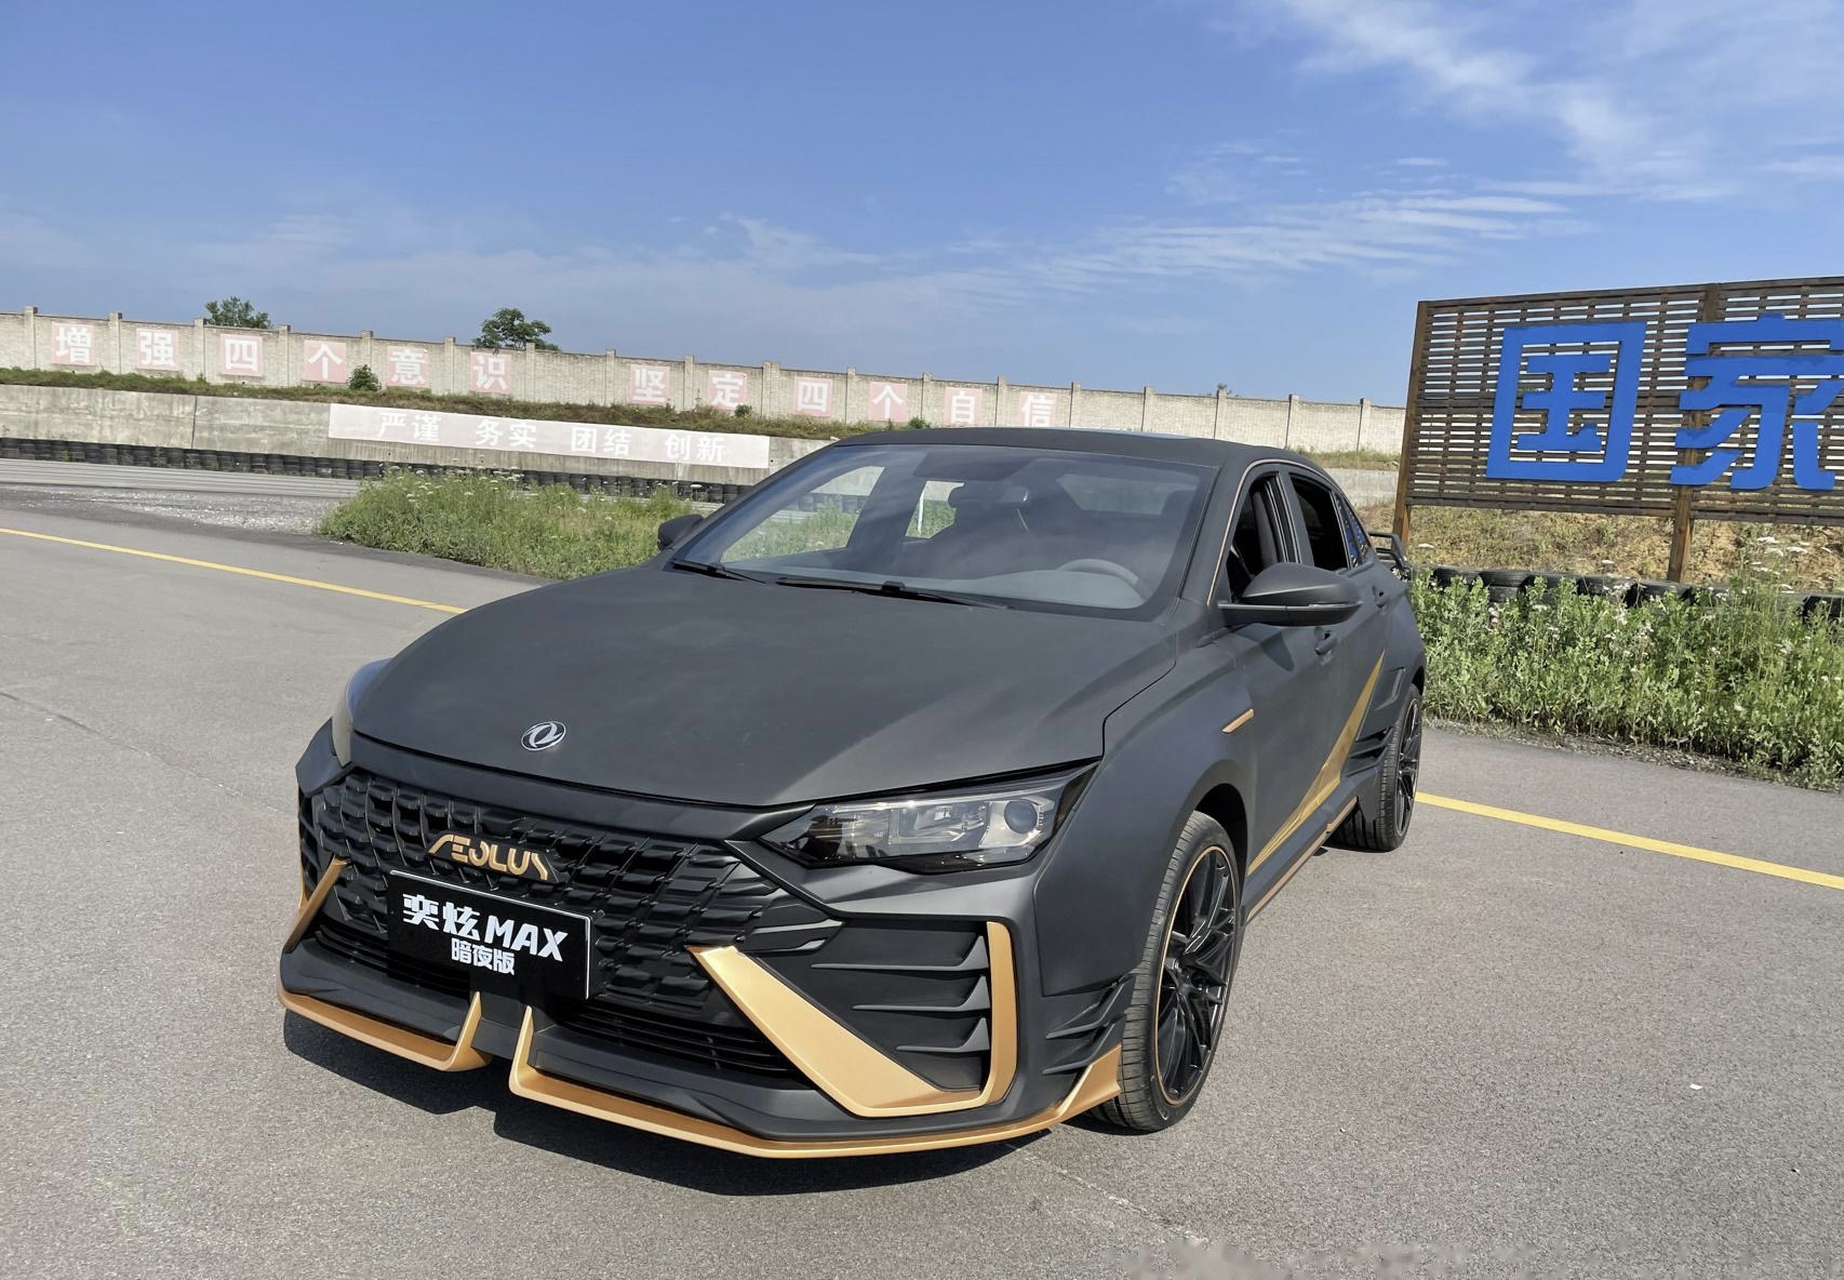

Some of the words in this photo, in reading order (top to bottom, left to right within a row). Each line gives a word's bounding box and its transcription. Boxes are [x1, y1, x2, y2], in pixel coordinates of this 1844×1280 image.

[54, 328, 512, 392] 增强四个意识
[632, 369, 1059, 428] 坚定四个自信
[1486, 313, 1844, 491] 国家
[379, 413, 442, 443] 严谨
[475, 418, 538, 449] 务实
[570, 426, 632, 456] 团结
[665, 433, 726, 462] 创新
[451, 937, 515, 975] 暗夜版
